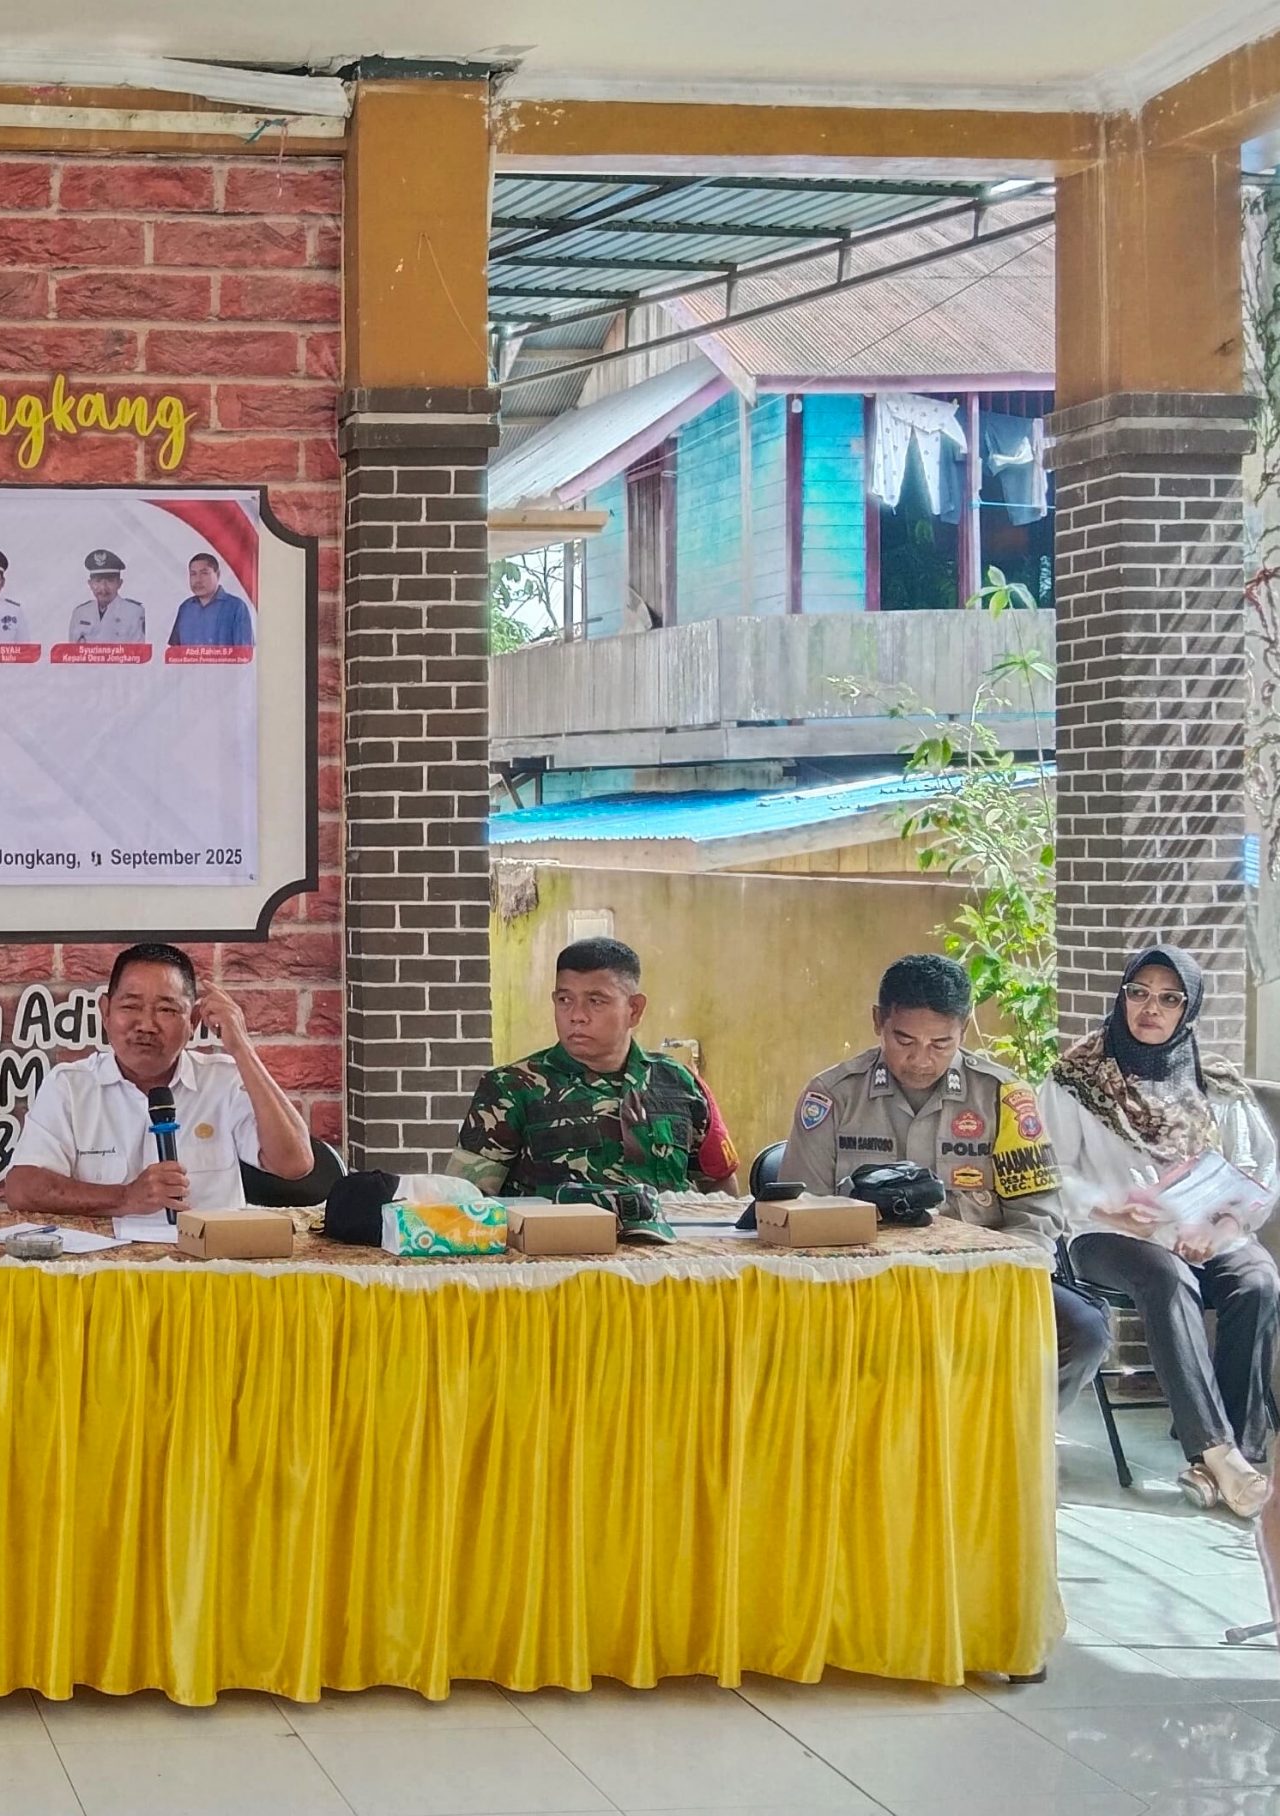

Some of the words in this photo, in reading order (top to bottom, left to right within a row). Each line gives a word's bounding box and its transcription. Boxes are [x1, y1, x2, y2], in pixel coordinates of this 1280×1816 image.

[110, 849, 201, 868] September
[205, 849, 243, 865] 2025
[941, 1141, 992, 1157] POLRI
